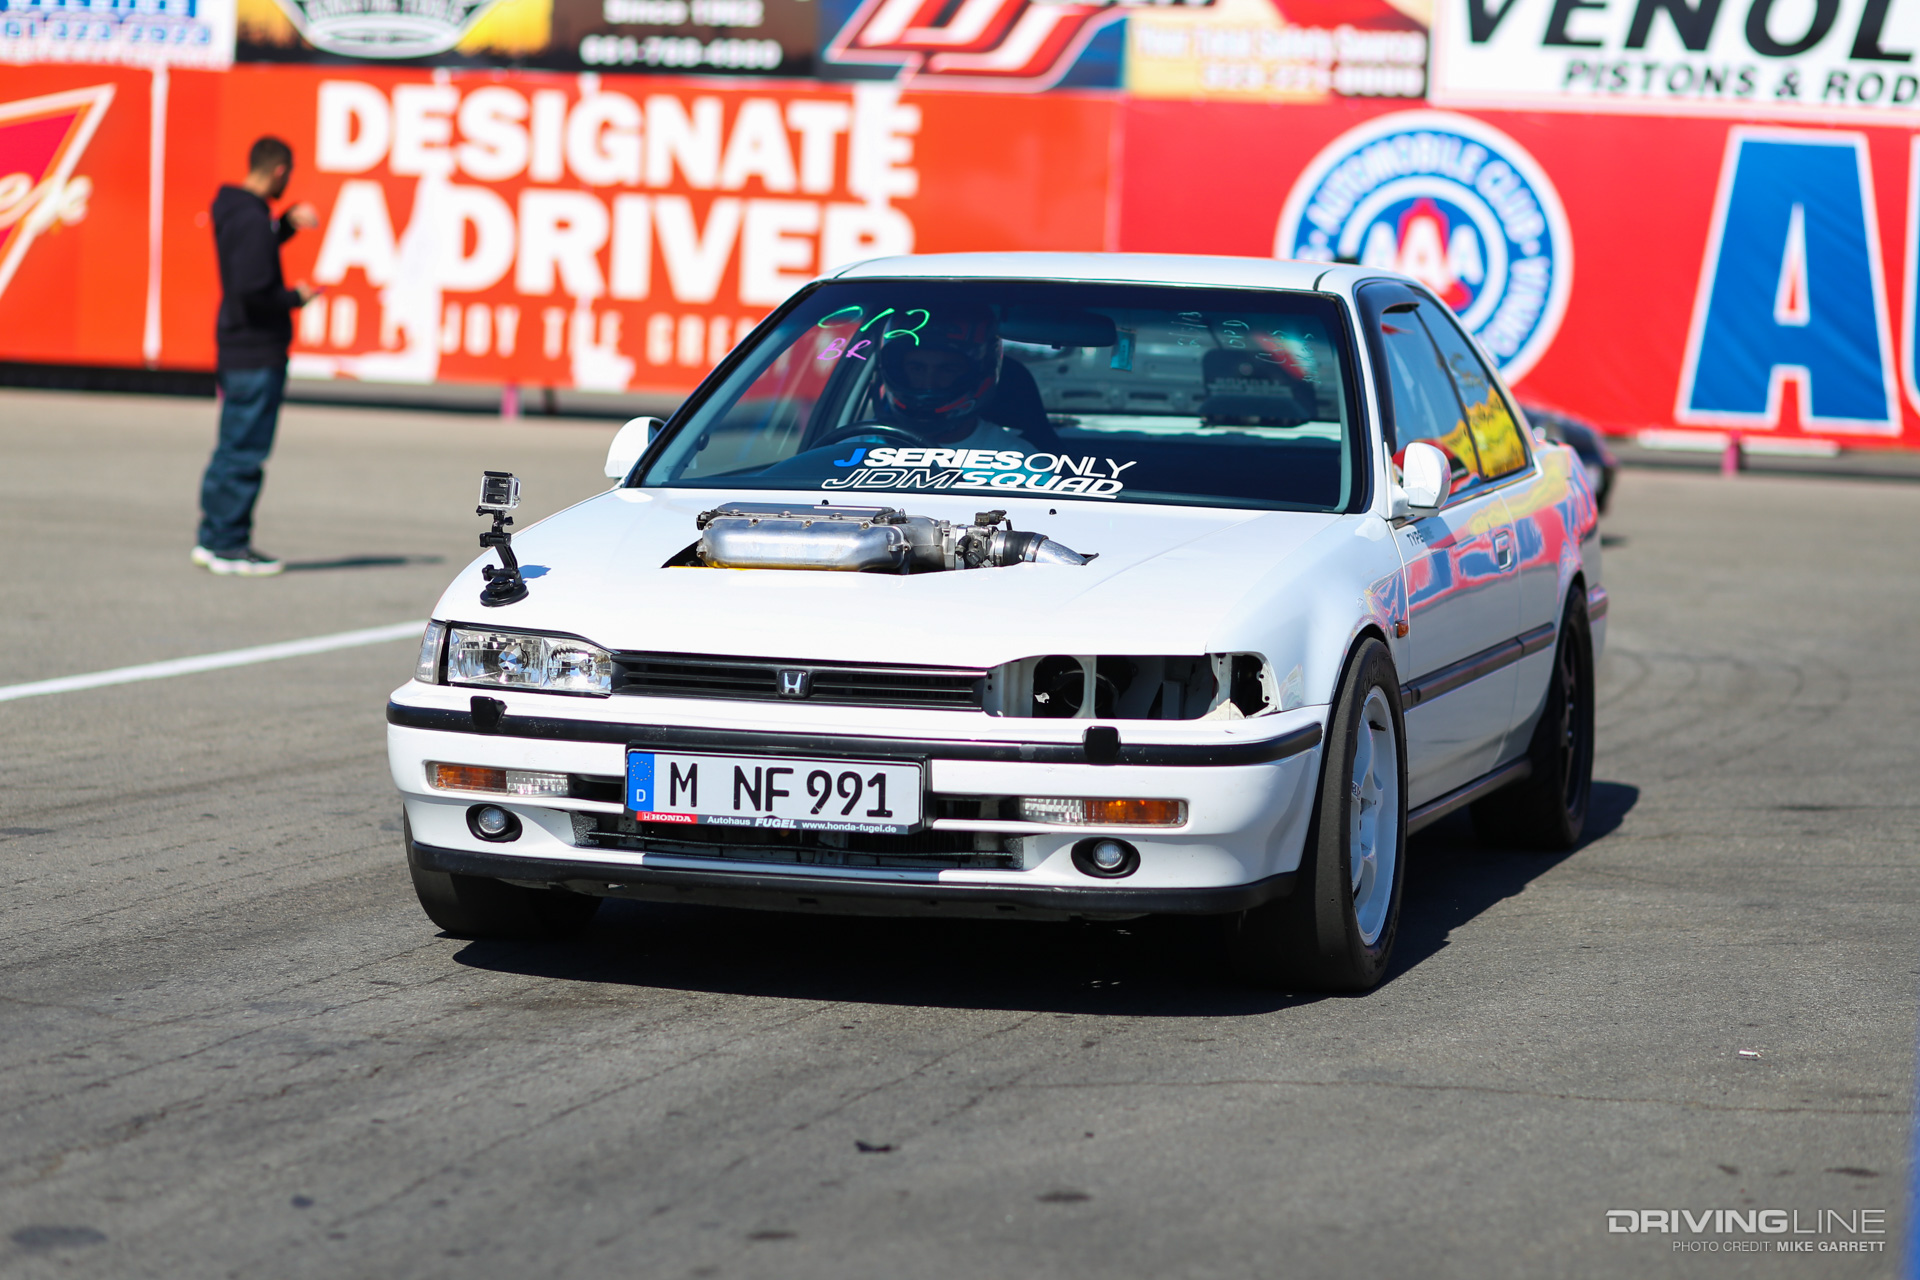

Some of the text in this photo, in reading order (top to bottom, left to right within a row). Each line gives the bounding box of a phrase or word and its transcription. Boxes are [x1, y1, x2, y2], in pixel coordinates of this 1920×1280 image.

[1562, 60, 1758, 97] PISTONS
[1775, 69, 1802, 98] &
[315, 79, 921, 199] DESIGNATE
[1306, 131, 1545, 243] AUTOMOBILE CLUB
[1356, 214, 1486, 296] AAA
[816, 337, 872, 361] BR
[636, 788, 646, 802] D
[669, 761, 893, 818] M NF 991
[651, 813, 897, 834] HONDA Autohaus FUGEL www.honda-fugel.de
